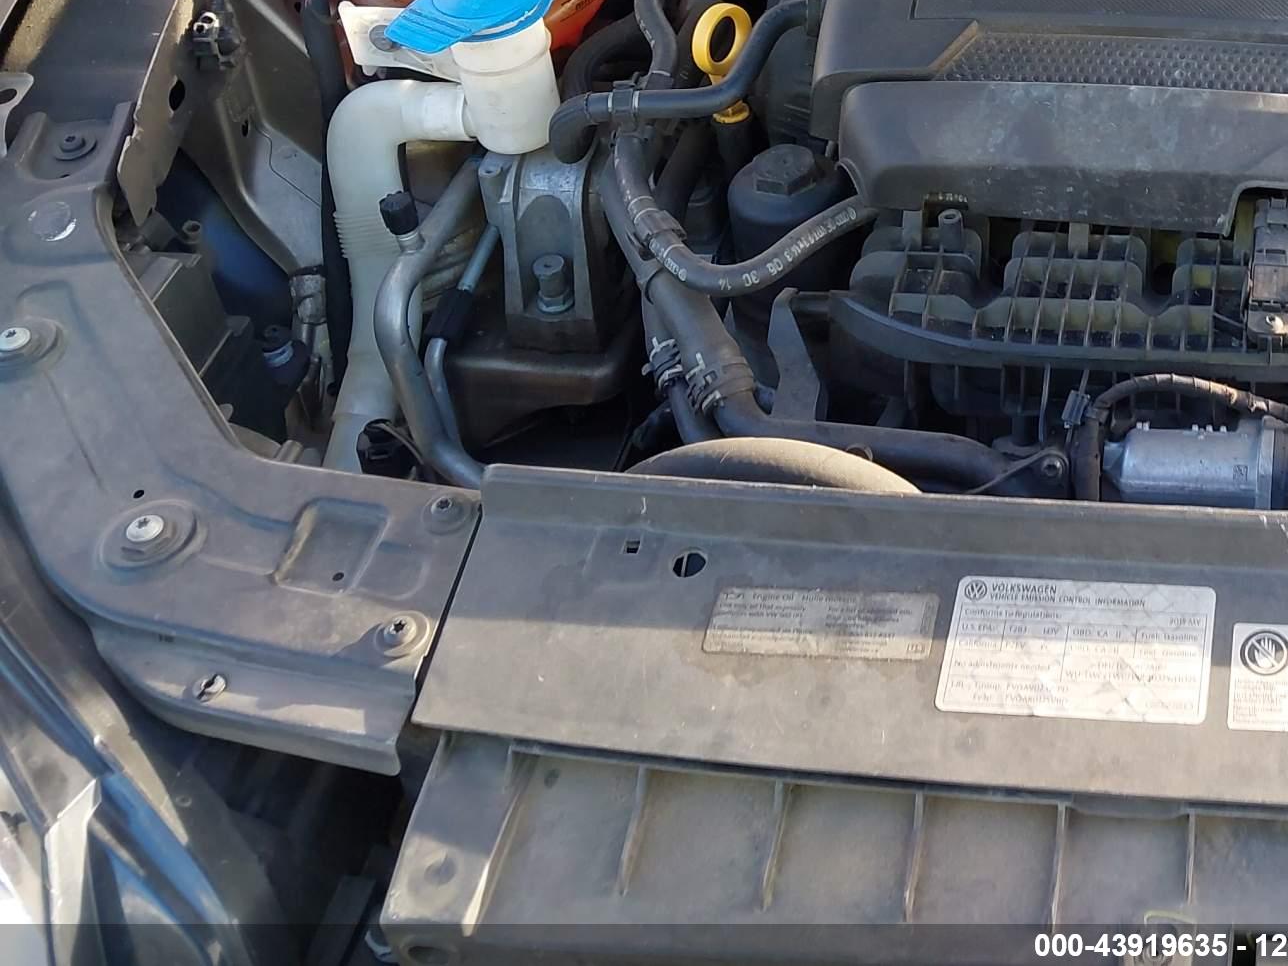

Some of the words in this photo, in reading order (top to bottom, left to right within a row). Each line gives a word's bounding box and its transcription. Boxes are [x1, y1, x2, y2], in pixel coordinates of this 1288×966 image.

[992, 582, 1057, 594] VOLKSWAGEN
[990, 593, 1018, 602] VEHICLE
[1021, 594, 1056, 603] EMISSION
[1059, 595, 1091, 605] CONTROL
[1095, 597, 1145, 607] INFORMATION
